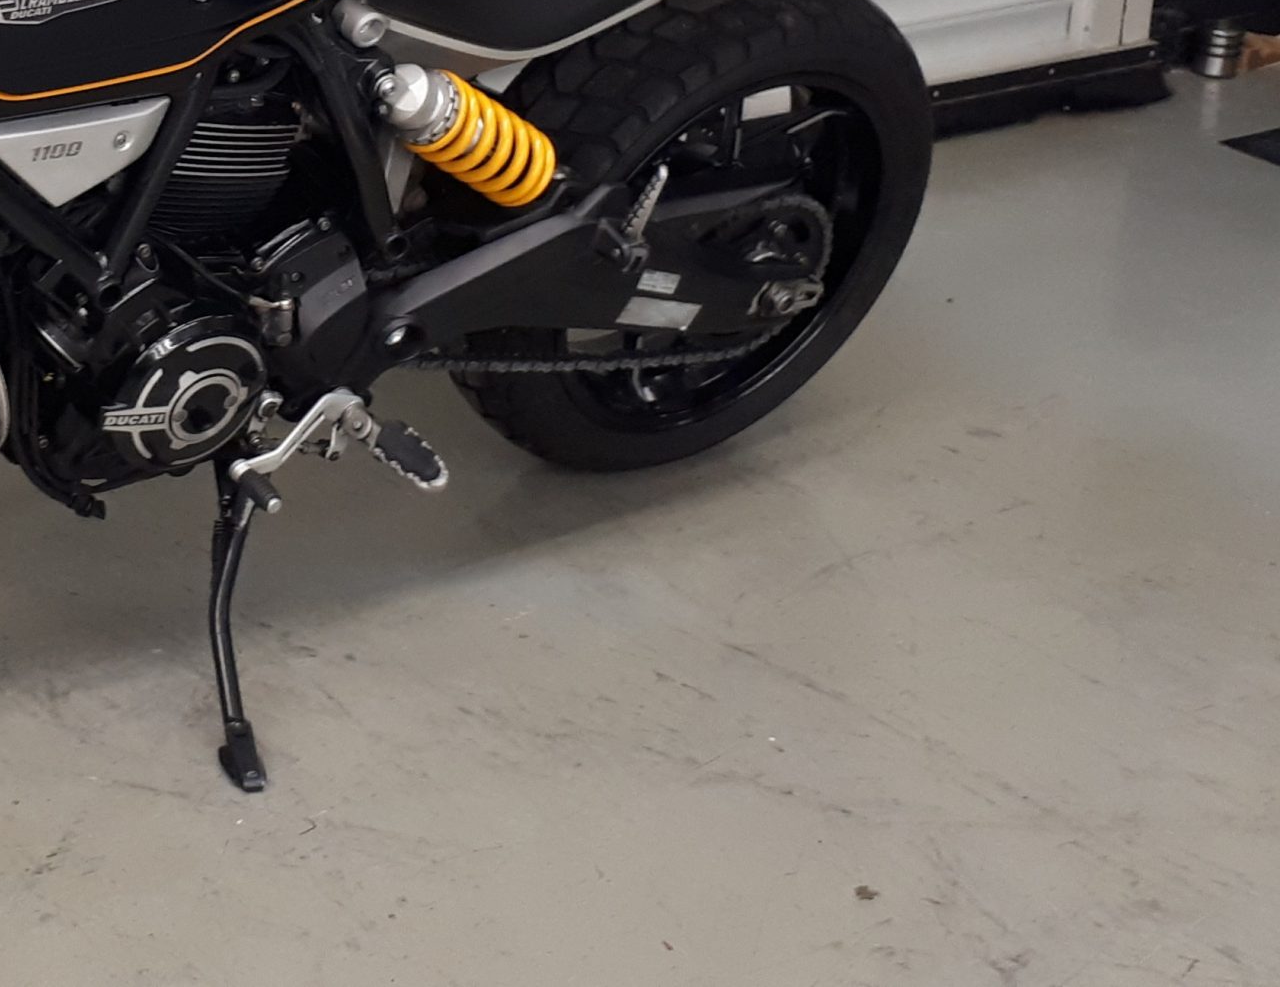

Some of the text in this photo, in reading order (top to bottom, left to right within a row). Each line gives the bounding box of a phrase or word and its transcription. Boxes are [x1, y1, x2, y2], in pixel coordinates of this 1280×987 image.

[9, 6, 52, 19] DUCATI
[32, 142, 83, 161] 1100
[104, 414, 164, 425] DUCATI
